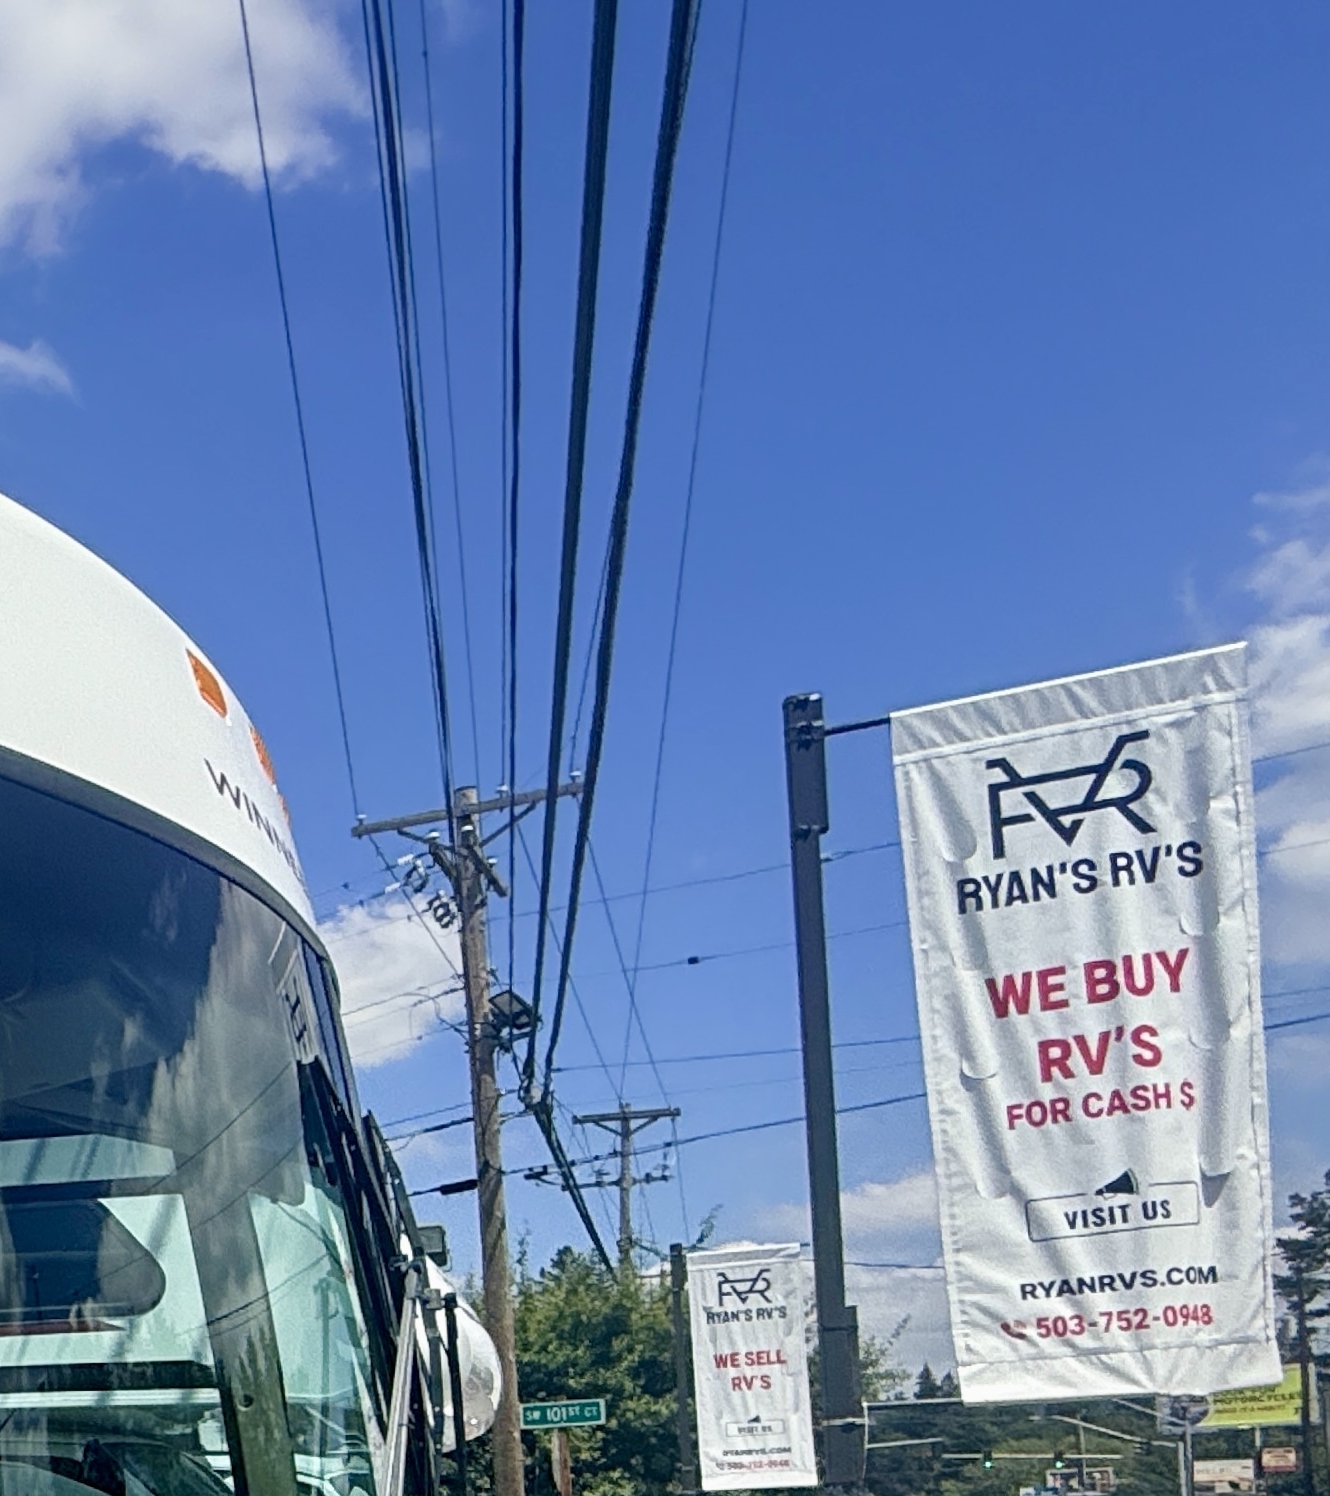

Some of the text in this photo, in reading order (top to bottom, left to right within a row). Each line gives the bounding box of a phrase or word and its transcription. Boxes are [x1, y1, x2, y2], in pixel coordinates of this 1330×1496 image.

[957, 840, 1203, 915] RYAN'S RV'S
[985, 948, 1189, 1019] WE BUY
[1038, 1024, 1163, 1083] RV'S
[1006, 1078, 1196, 1130] FOR CASH $
[1064, 1200, 1172, 1229] VISIT US
[1020, 1265, 1218, 1300] RYANRVS.COM
[706, 1305, 787, 1324] RYAN'S RV'S
[1036, 1304, 1213, 1338] 503-752-0948
[713, 1350, 787, 1369] WE SELL
[732, 1375, 772, 1391] RV'S
